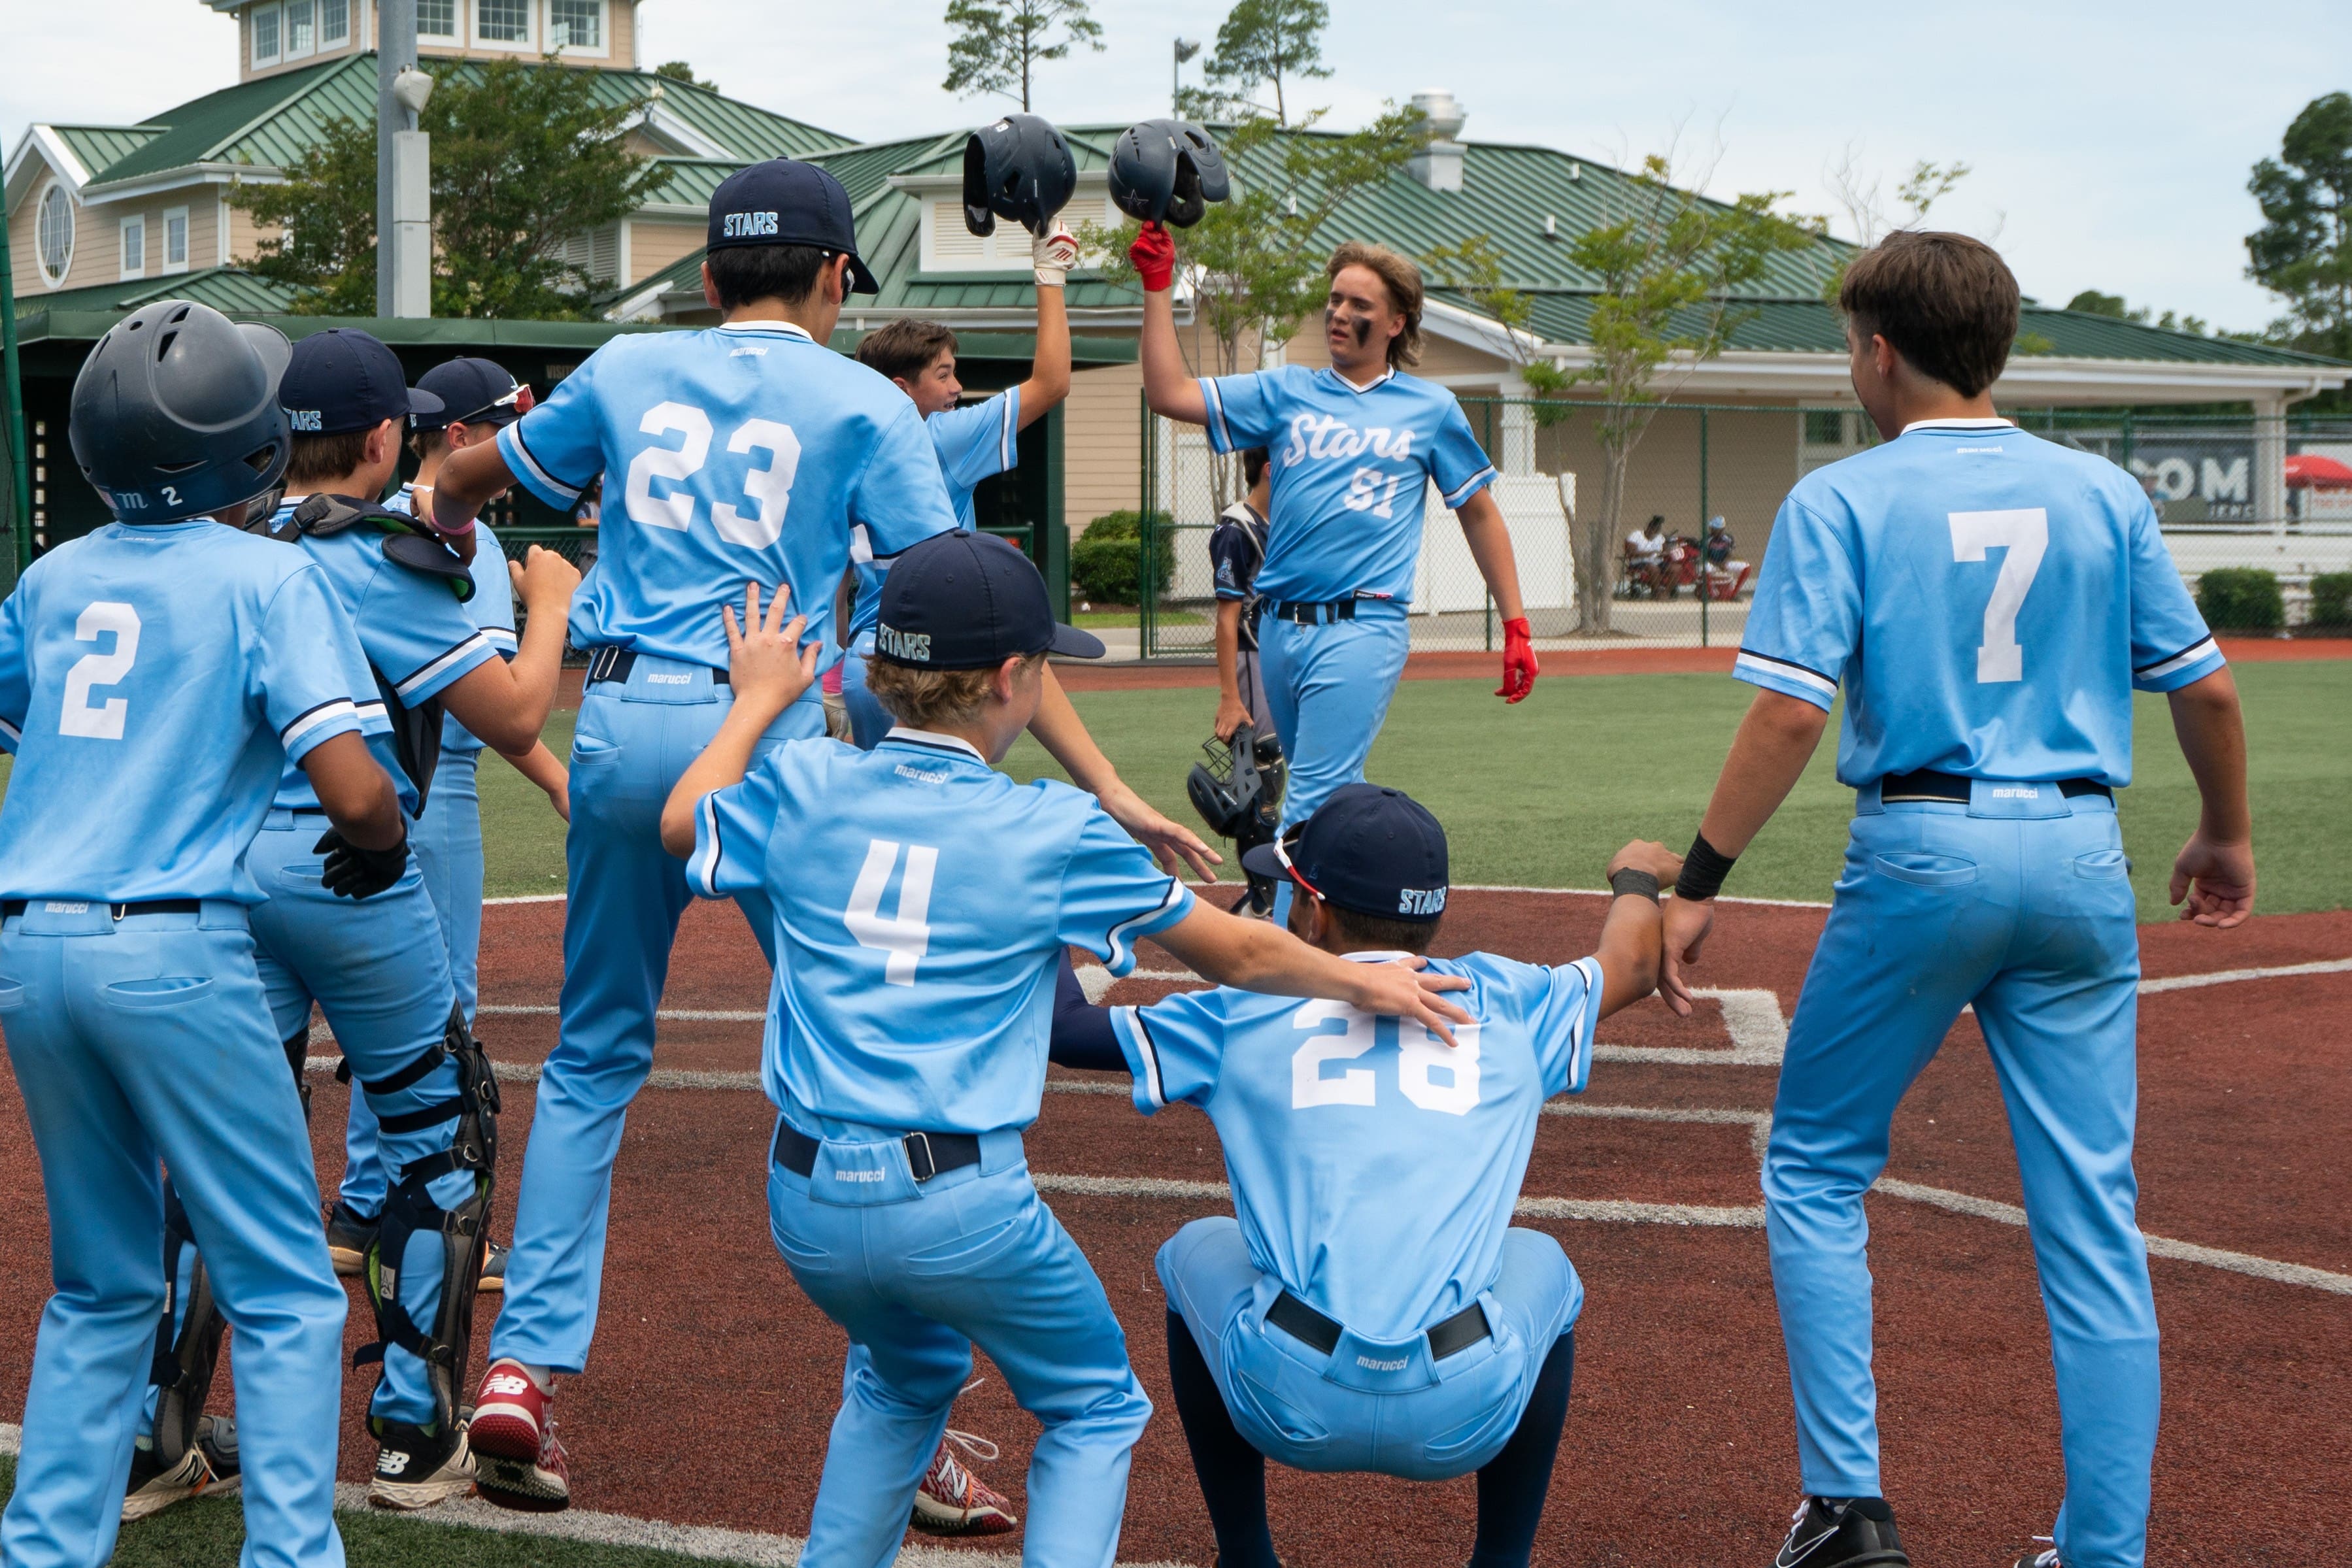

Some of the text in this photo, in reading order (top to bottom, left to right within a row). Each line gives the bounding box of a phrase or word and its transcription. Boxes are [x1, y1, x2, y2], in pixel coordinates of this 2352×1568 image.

[724, 211, 779, 237] STARS
[729, 346, 769, 357] marucci
[283, 407, 322, 431] ARS
[1283, 413, 1416, 468] Stars
[625, 401, 802, 550] 23
[161, 486, 184, 507] 2
[1344, 467, 1401, 519] 51
[1947, 507, 2049, 684] 7
[879, 622, 931, 662] STARS
[58, 601, 142, 741] 2
[647, 672, 693, 684] marucci
[894, 764, 949, 785] marucci
[1992, 788, 2039, 799] marucci
[44, 901, 90, 914] marucci
[843, 838, 939, 988] 4
[1399, 886, 1447, 914] STARS
[1292, 997, 1481, 1116] 28
[835, 1166, 886, 1183] marucci
[1356, 1355, 1409, 1371] marucci
